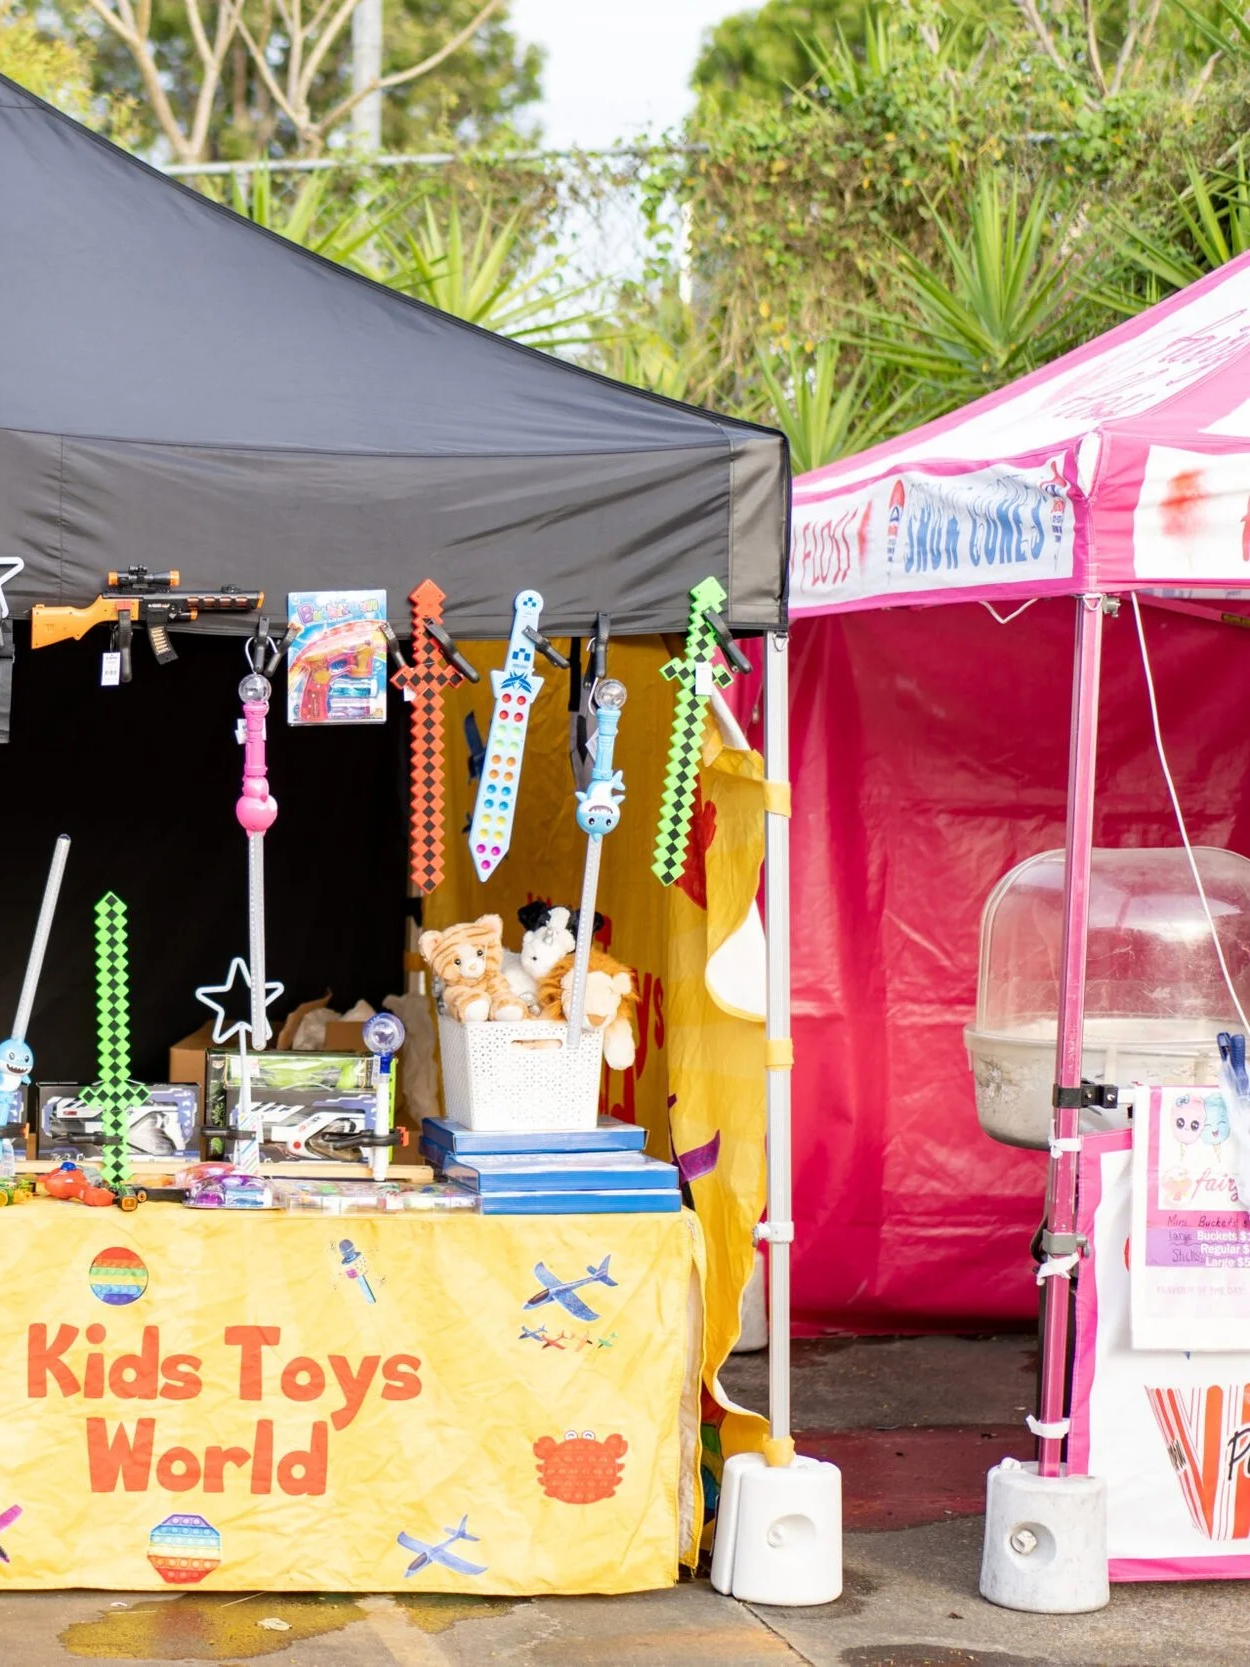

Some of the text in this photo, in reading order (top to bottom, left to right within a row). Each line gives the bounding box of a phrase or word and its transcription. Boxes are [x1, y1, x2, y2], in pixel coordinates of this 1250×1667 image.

[1196, 1230, 1238, 1241] Buckets
[1200, 1243, 1241, 1256] Regular
[1205, 1257, 1236, 1269] Large
[28, 1322, 422, 1431] Kids Toys
[86, 1416, 329, 1496] World
